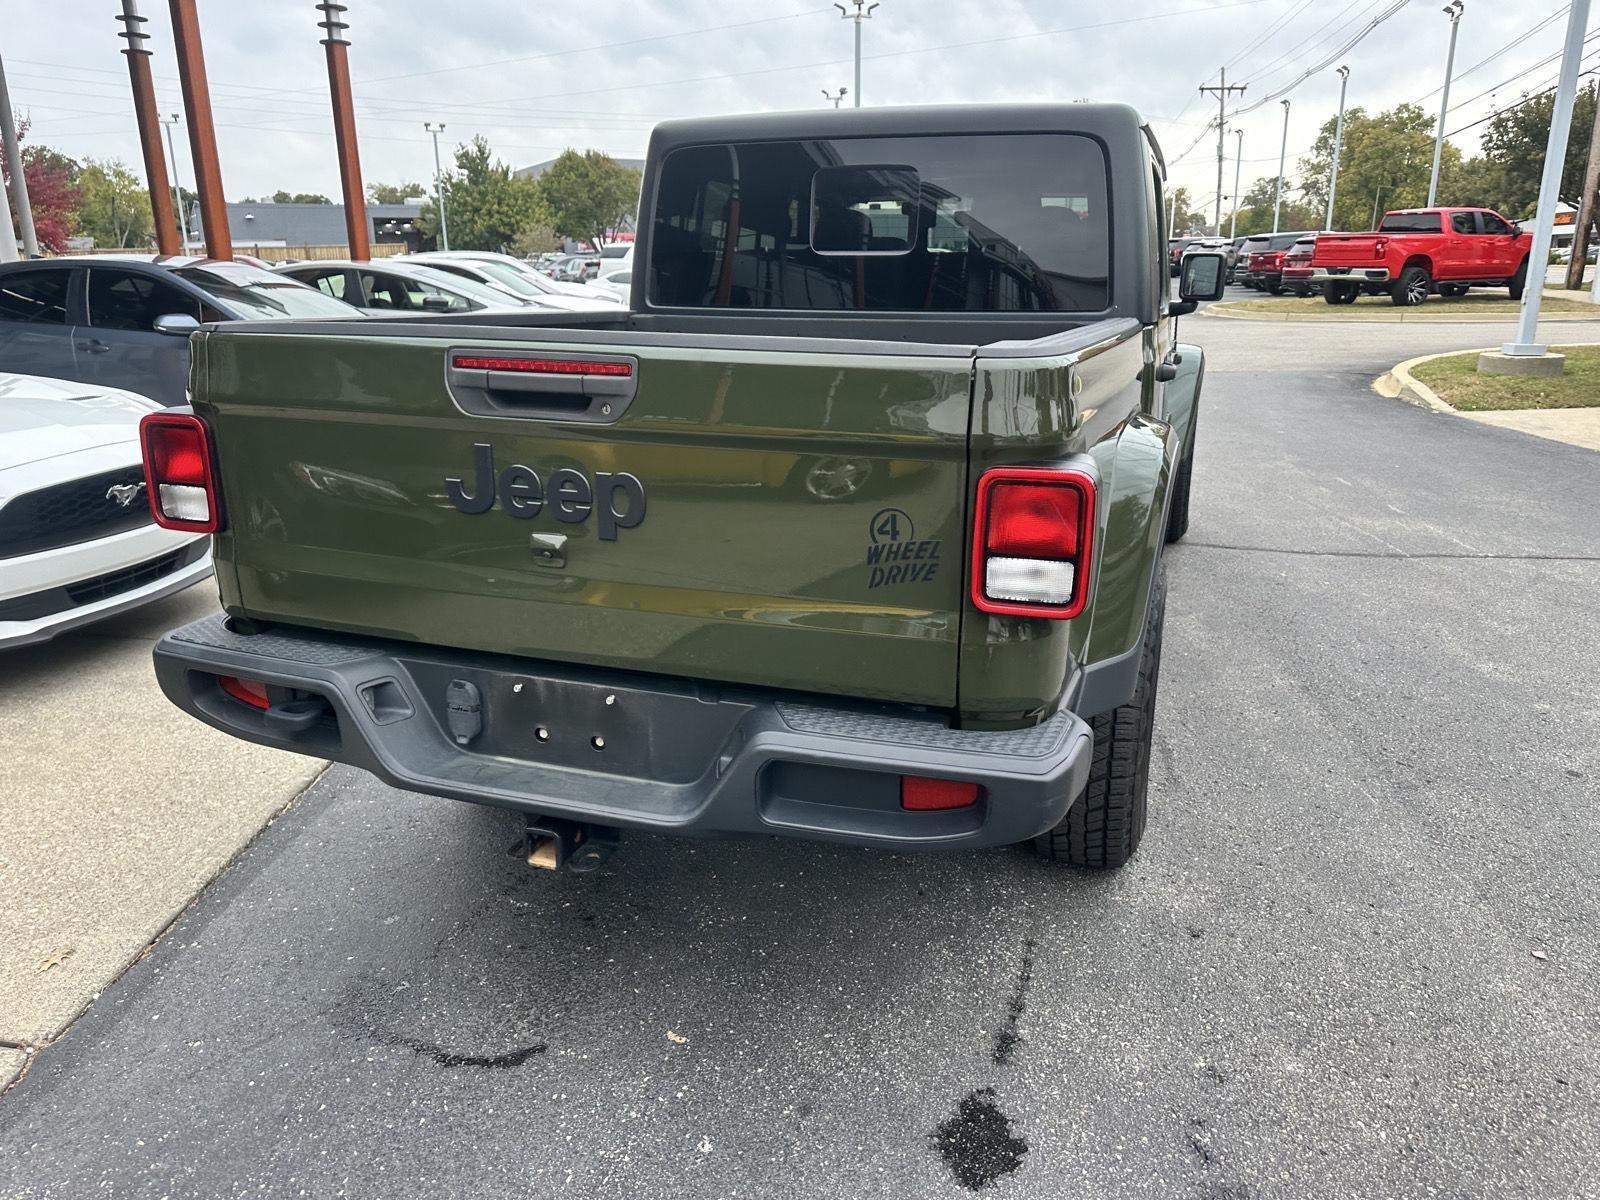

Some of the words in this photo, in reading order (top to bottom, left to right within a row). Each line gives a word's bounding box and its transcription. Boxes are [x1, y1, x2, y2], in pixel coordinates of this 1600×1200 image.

[446, 442, 647, 541] Jeep
[877, 513, 900, 541] 4
[867, 540, 942, 565] WHEEL
[868, 563, 940, 589] DRIVE
